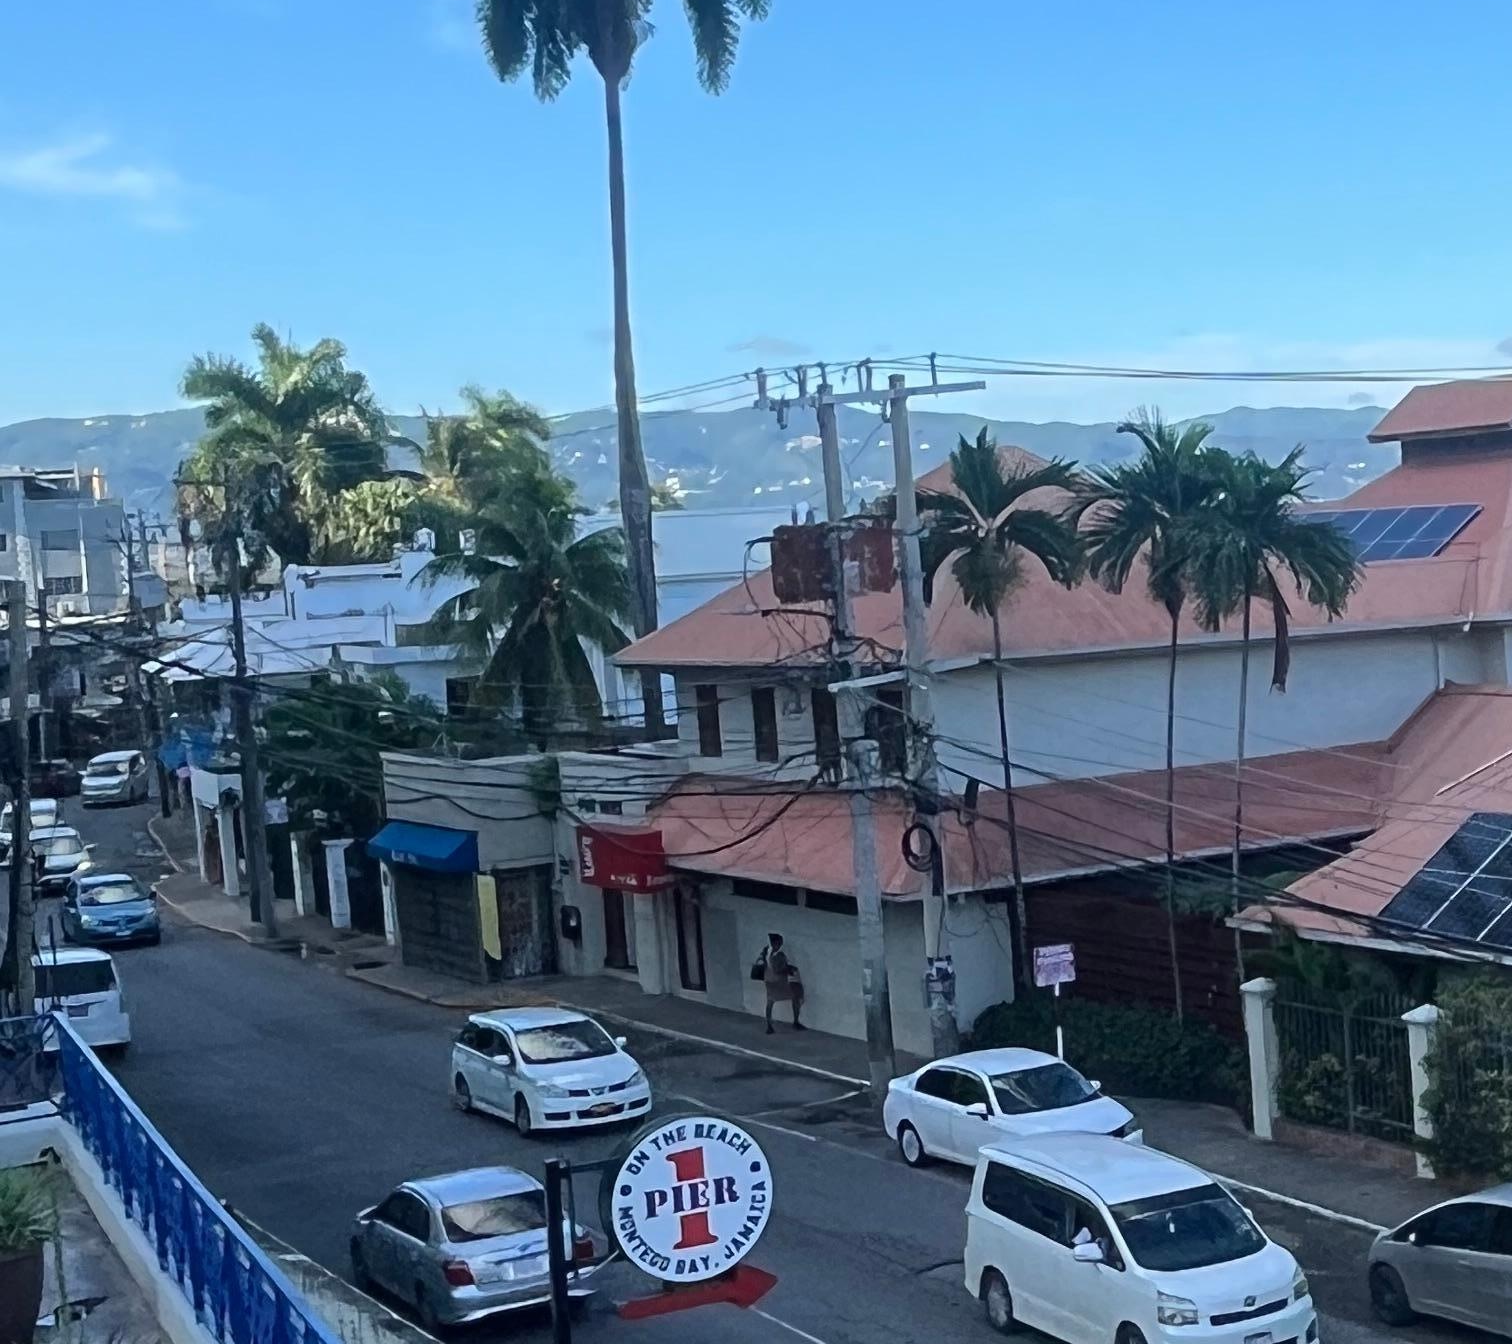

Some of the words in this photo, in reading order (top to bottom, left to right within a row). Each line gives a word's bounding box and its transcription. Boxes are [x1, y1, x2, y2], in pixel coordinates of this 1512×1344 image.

[626, 1150, 650, 1175] ON
[649, 1125, 687, 1151] THE
[694, 1123, 752, 1156] BEACH
[618, 1206, 671, 1272] MONTEGO
[724, 1180, 766, 1260] JAMAICA
[644, 1176, 740, 1221] PIER
[665, 1146, 719, 1250] 1
